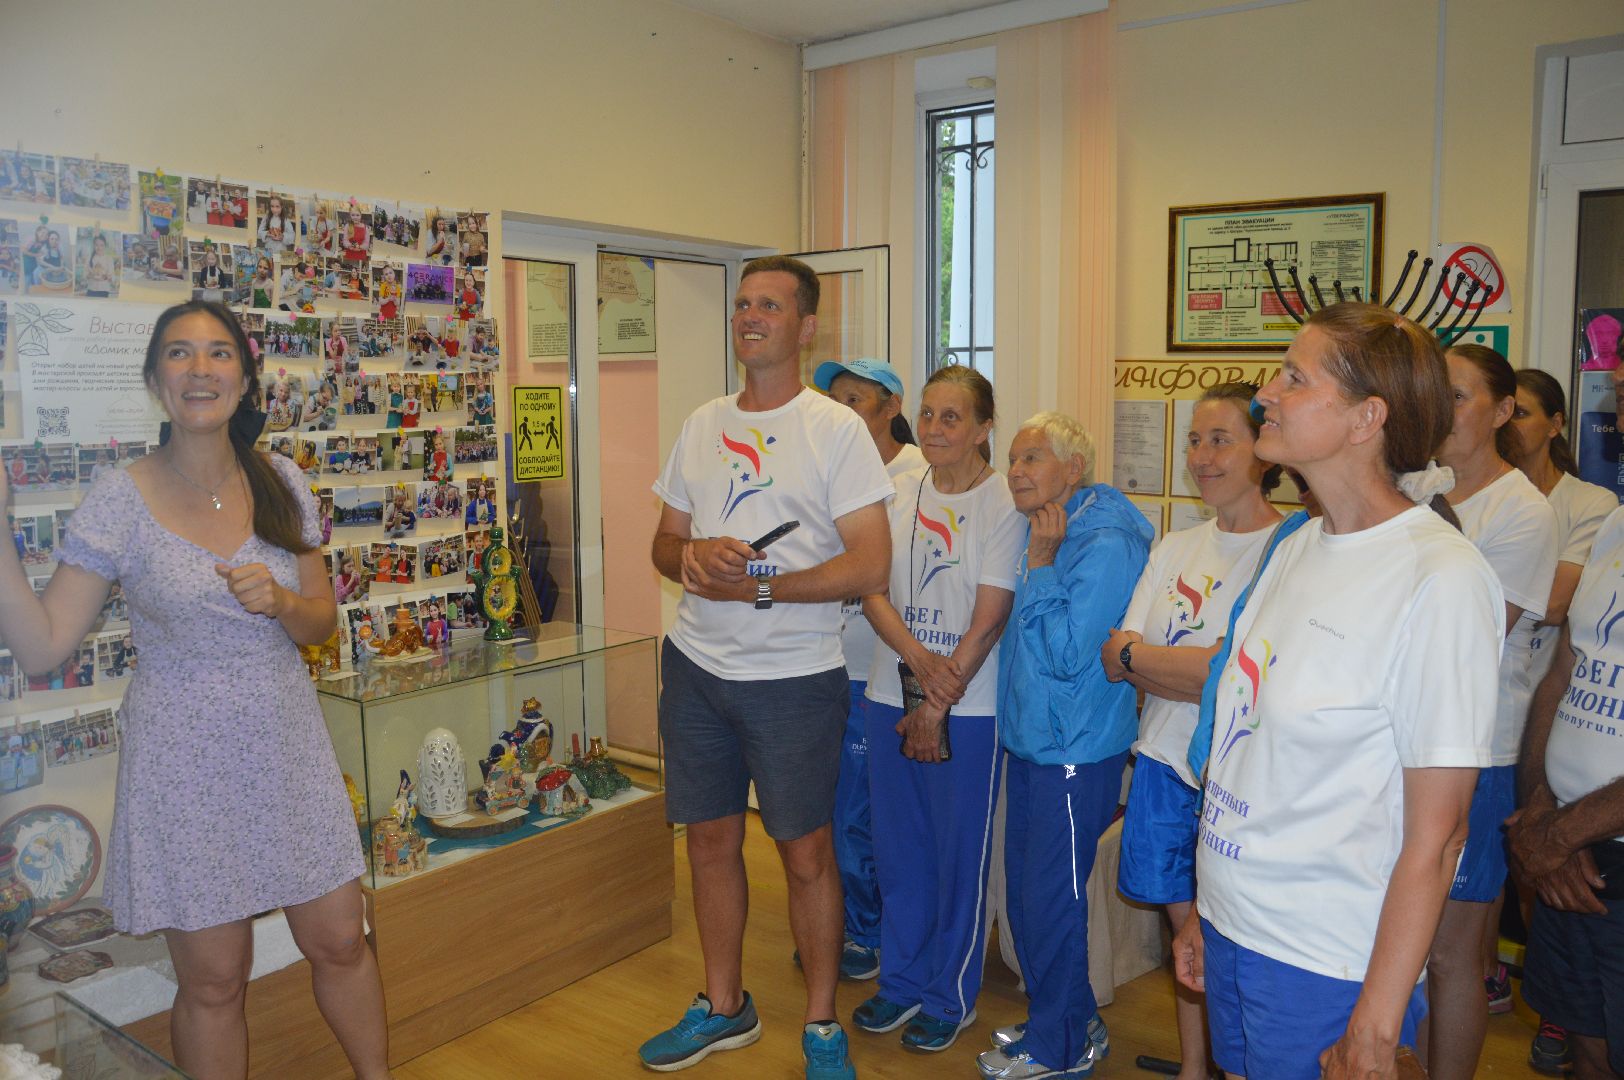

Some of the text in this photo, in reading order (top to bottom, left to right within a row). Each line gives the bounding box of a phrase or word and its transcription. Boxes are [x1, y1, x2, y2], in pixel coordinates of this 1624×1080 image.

[525, 392, 550, 401] ХОДИТЕ
[519, 402, 557, 412] ПО ОДНОМУ
[1592, 424, 1615, 433] Тебе
[518, 454, 561, 465] СОБЛЮДАЙТЕ
[520, 465, 560, 476] ДИСТАНЦИЮ!
[904, 605, 942, 626] БЕГ
[1308, 618, 1345, 640] Quechua
[1574, 655, 1624, 689] БЕГ
